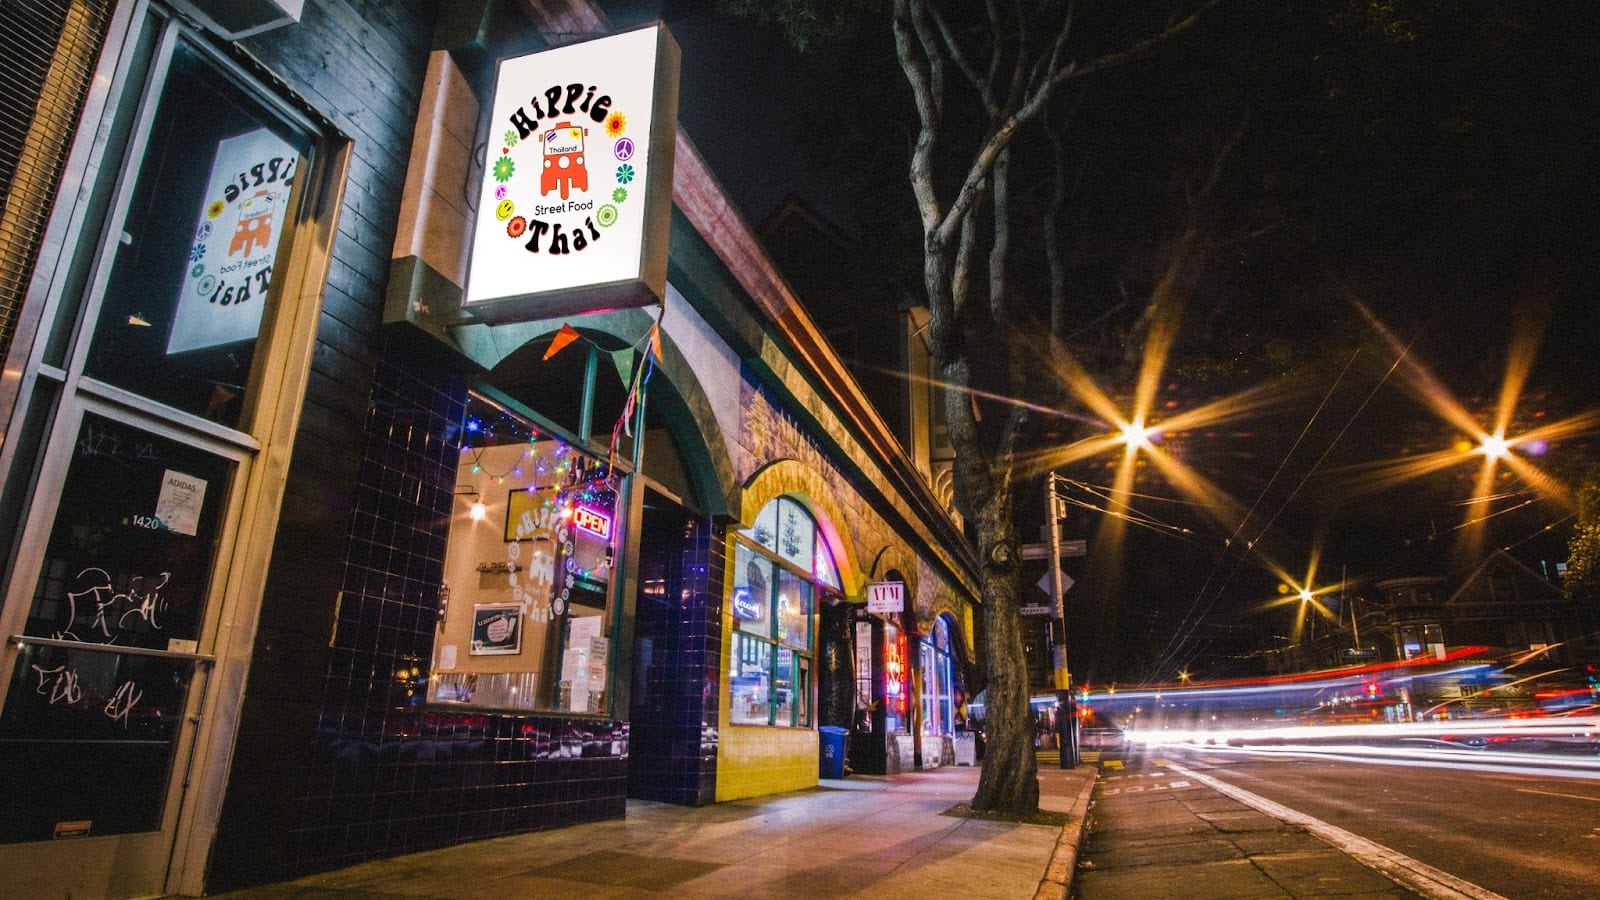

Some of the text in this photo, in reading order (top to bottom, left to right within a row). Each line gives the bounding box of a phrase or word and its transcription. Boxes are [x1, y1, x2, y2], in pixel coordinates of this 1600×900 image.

[549, 145, 577, 153] Thailand
[535, 199, 593, 216] Street Food
[525, 216, 601, 255] Thai
[168, 478, 197, 493] ADIDAS
[132, 514, 159, 529] 1420
[574, 507, 607, 535] OPEN
[874, 586, 899, 600] ATM
